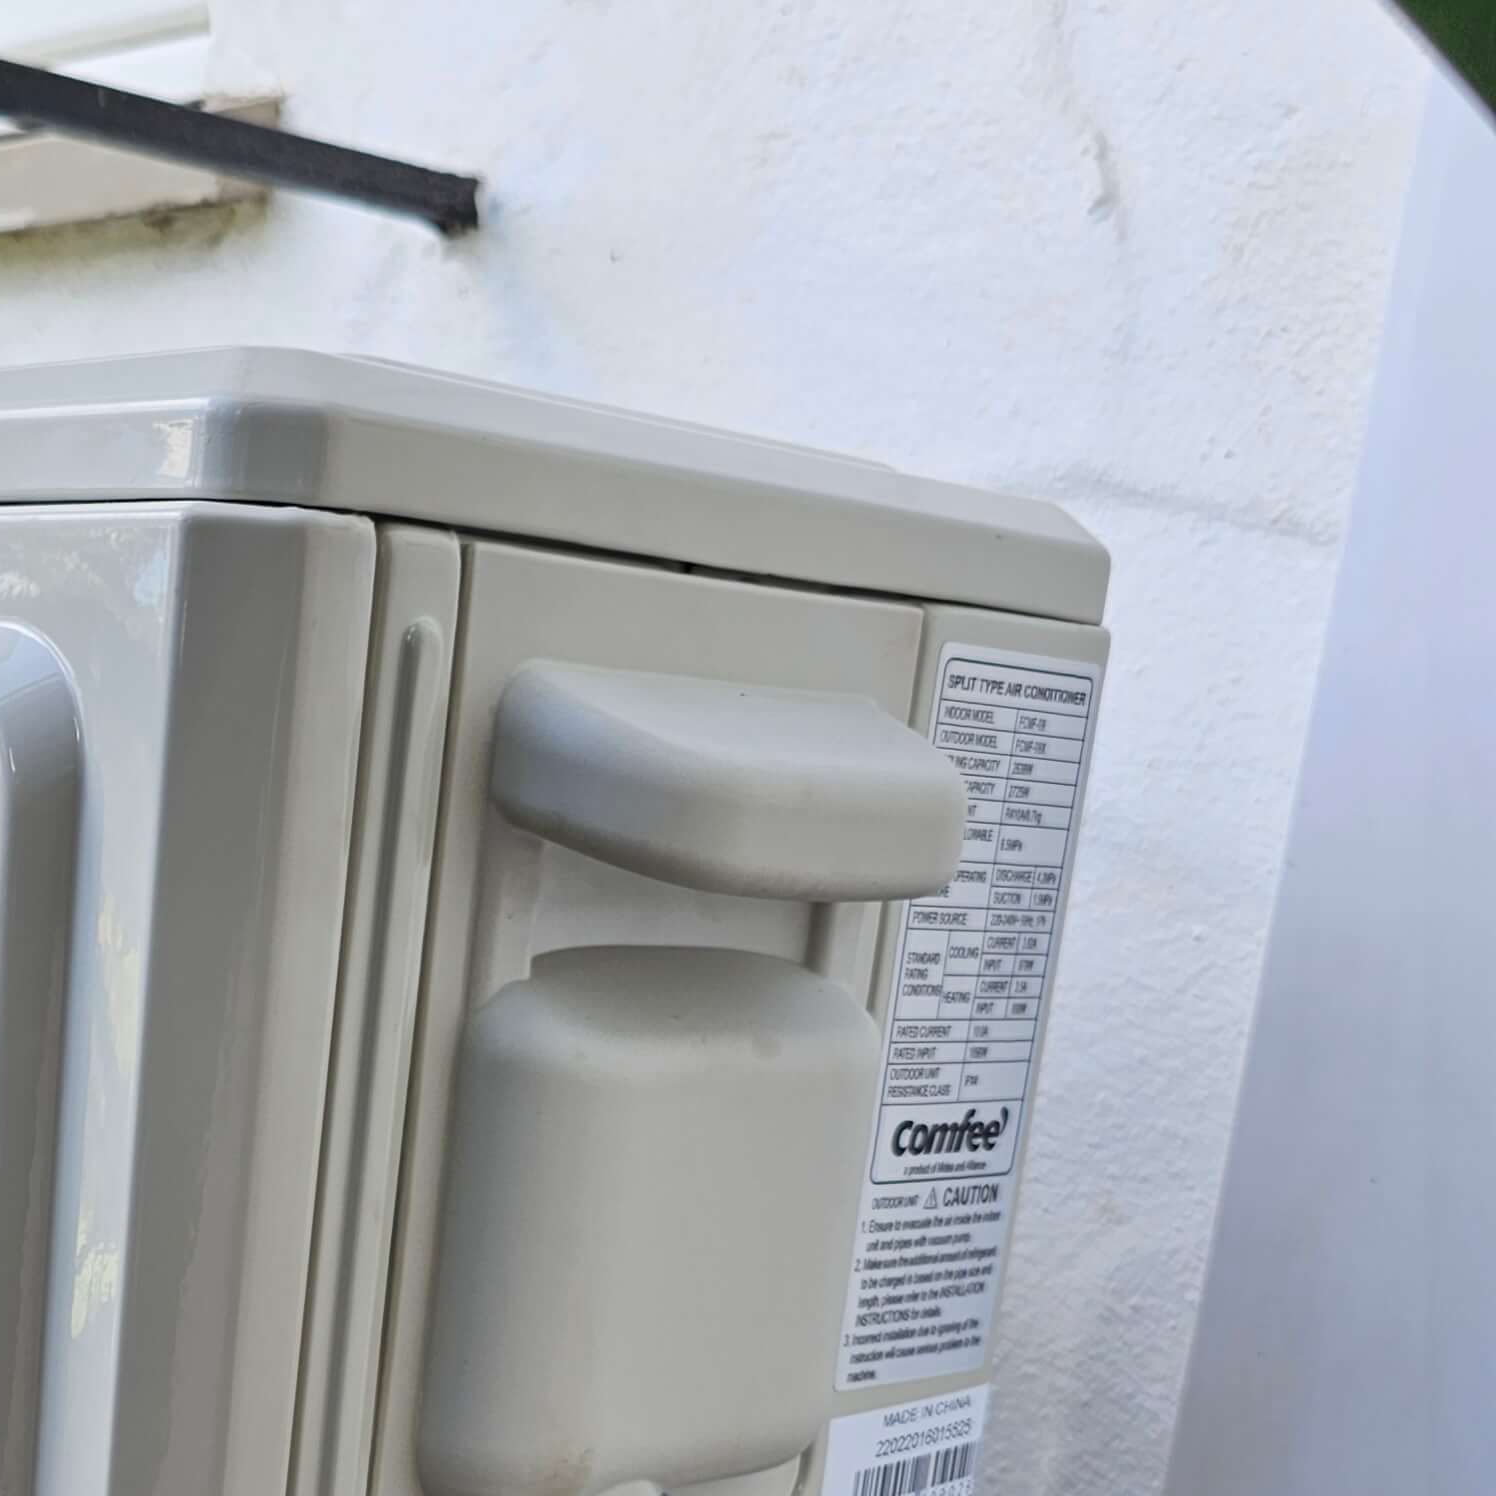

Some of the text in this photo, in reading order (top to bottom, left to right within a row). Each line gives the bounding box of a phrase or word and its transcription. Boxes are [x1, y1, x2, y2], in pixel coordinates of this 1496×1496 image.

[948, 674, 1086, 706] SPLIT TYPE AIR CONDITIONER
[942, 1183, 999, 1208] CAUTION
[883, 1395, 972, 1428] MADE IN CHINA
